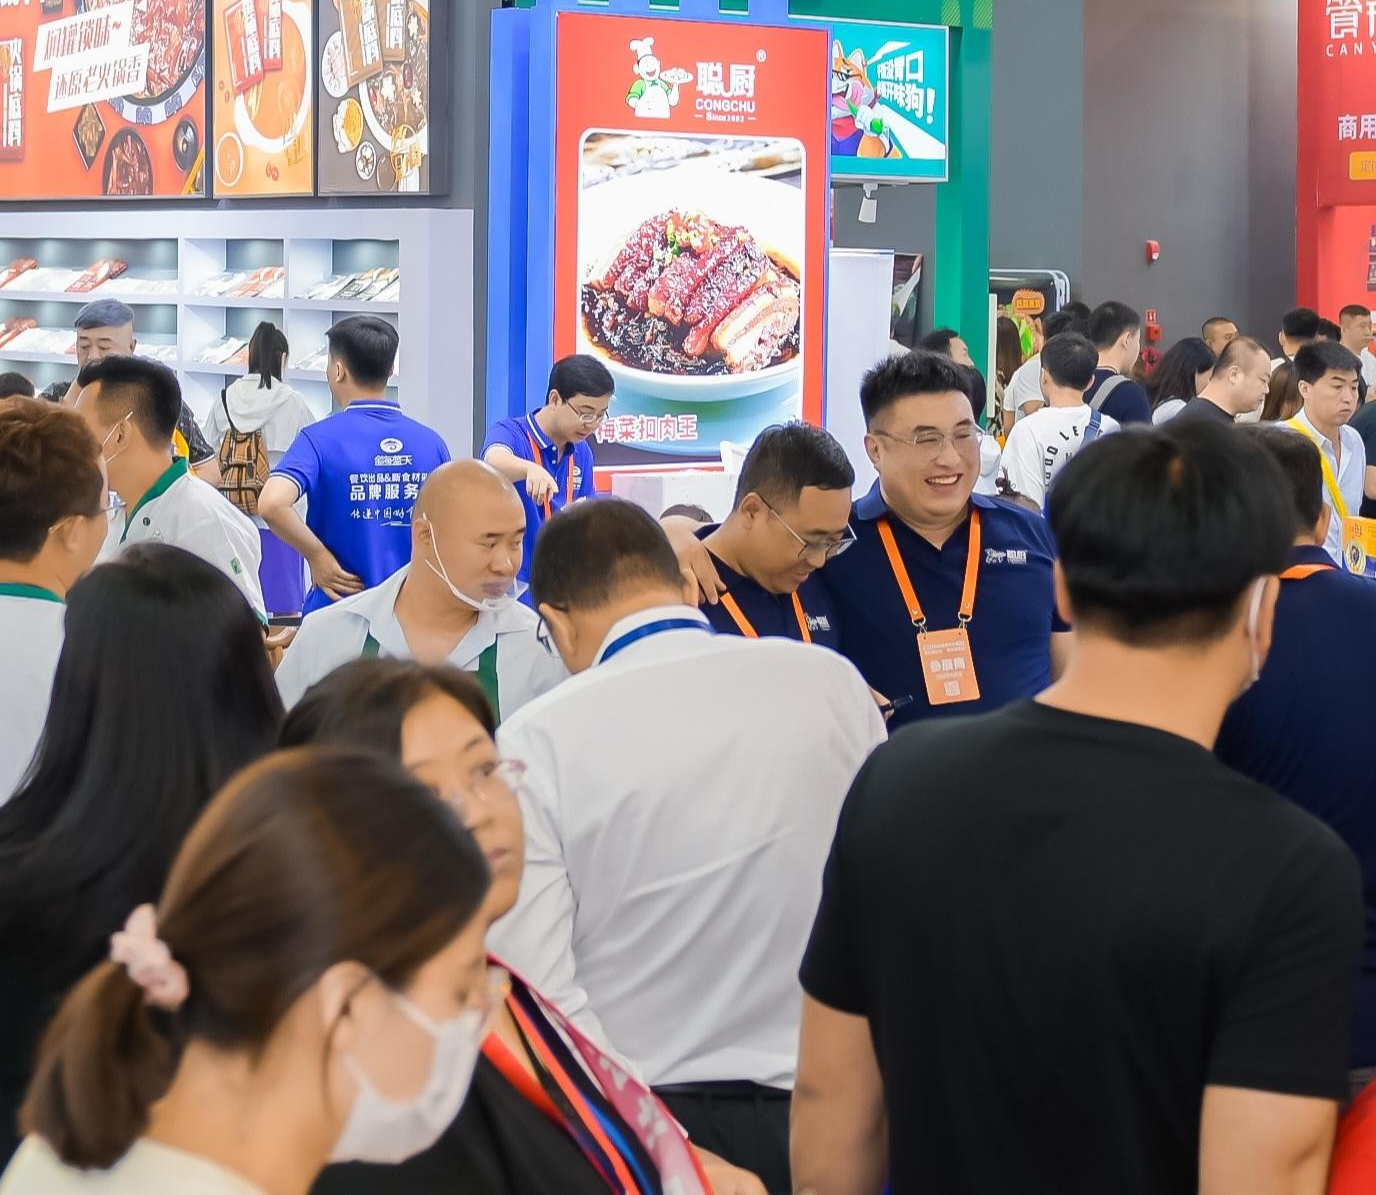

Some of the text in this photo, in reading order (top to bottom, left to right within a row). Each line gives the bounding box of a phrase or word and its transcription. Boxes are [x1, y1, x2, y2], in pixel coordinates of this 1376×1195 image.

[696, 61, 756, 100] 聪厨
[696, 98, 756, 114] CONGCHU
[595, 415, 698, 443] 梅菜扣肉王
[350, 483, 419, 501] 品牌服务
